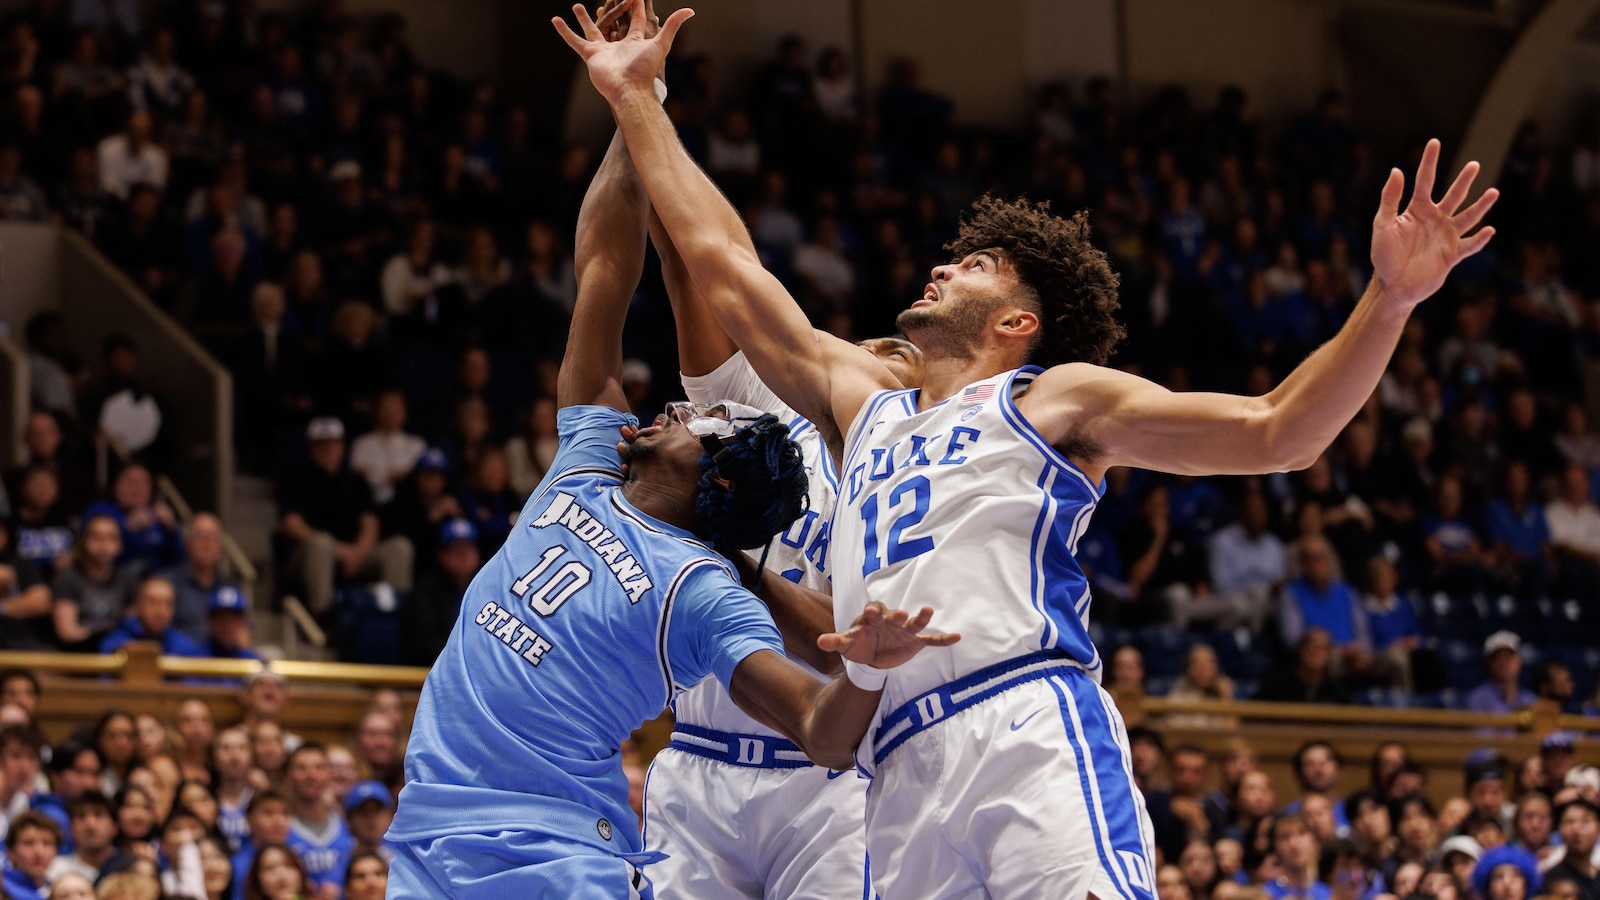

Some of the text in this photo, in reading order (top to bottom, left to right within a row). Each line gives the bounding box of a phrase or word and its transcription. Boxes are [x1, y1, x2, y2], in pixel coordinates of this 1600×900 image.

[848, 426, 981, 506] DUKE
[529, 491, 654, 606] INDIANA
[780, 511, 831, 573] UK
[861, 475, 935, 579] 12
[510, 544, 593, 619] 10
[475, 600, 553, 668] STATE
[915, 692, 944, 726] D
[736, 737, 765, 765] D
